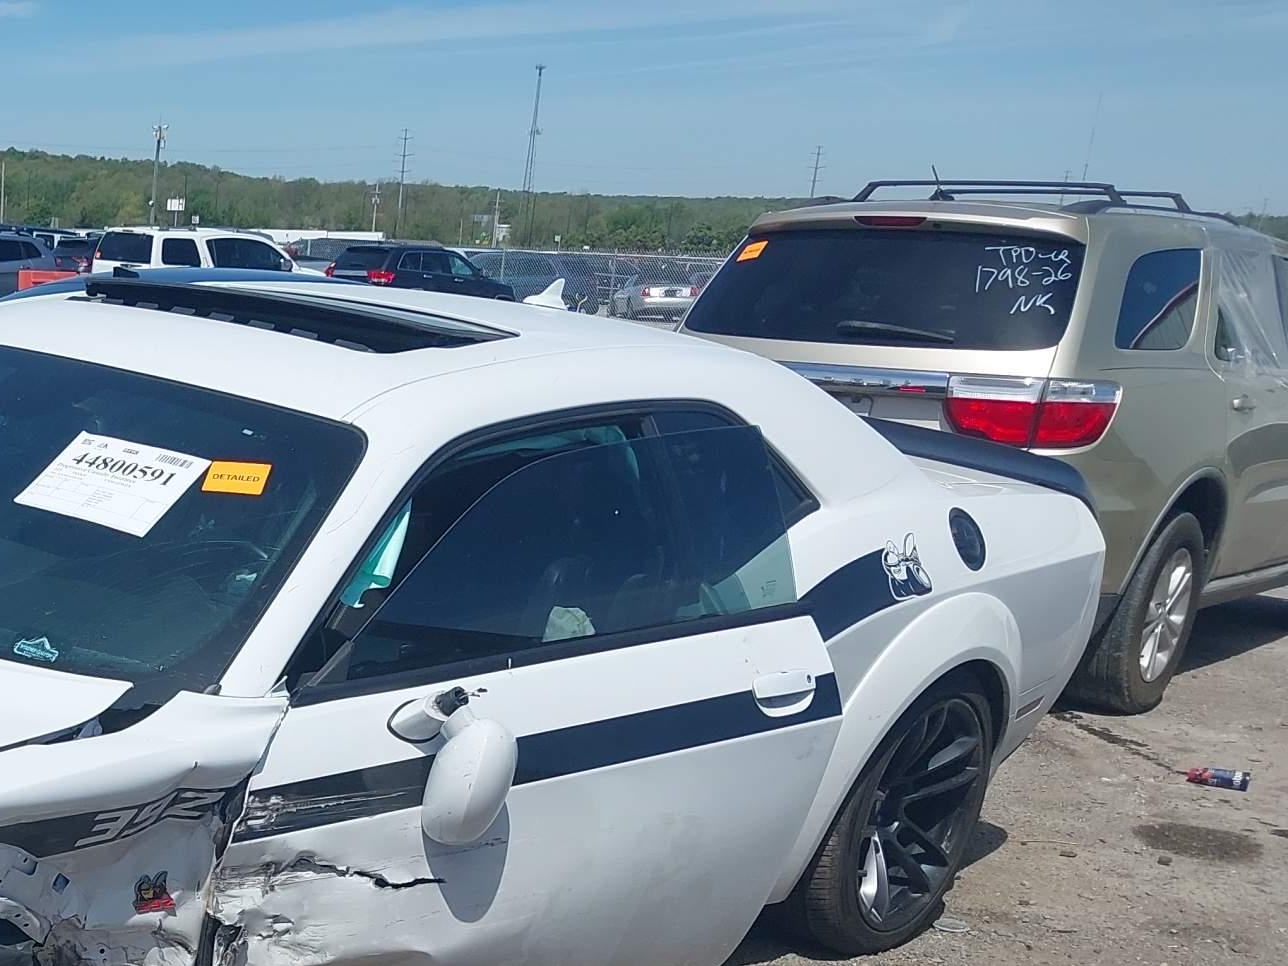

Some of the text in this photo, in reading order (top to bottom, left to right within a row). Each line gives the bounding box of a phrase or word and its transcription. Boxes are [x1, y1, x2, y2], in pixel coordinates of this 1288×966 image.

[975, 263, 1073, 293] 1798-26
[72, 451, 177, 487] 44800591
[212, 473, 261, 483] DETAILED
[73, 790, 228, 848] 392
